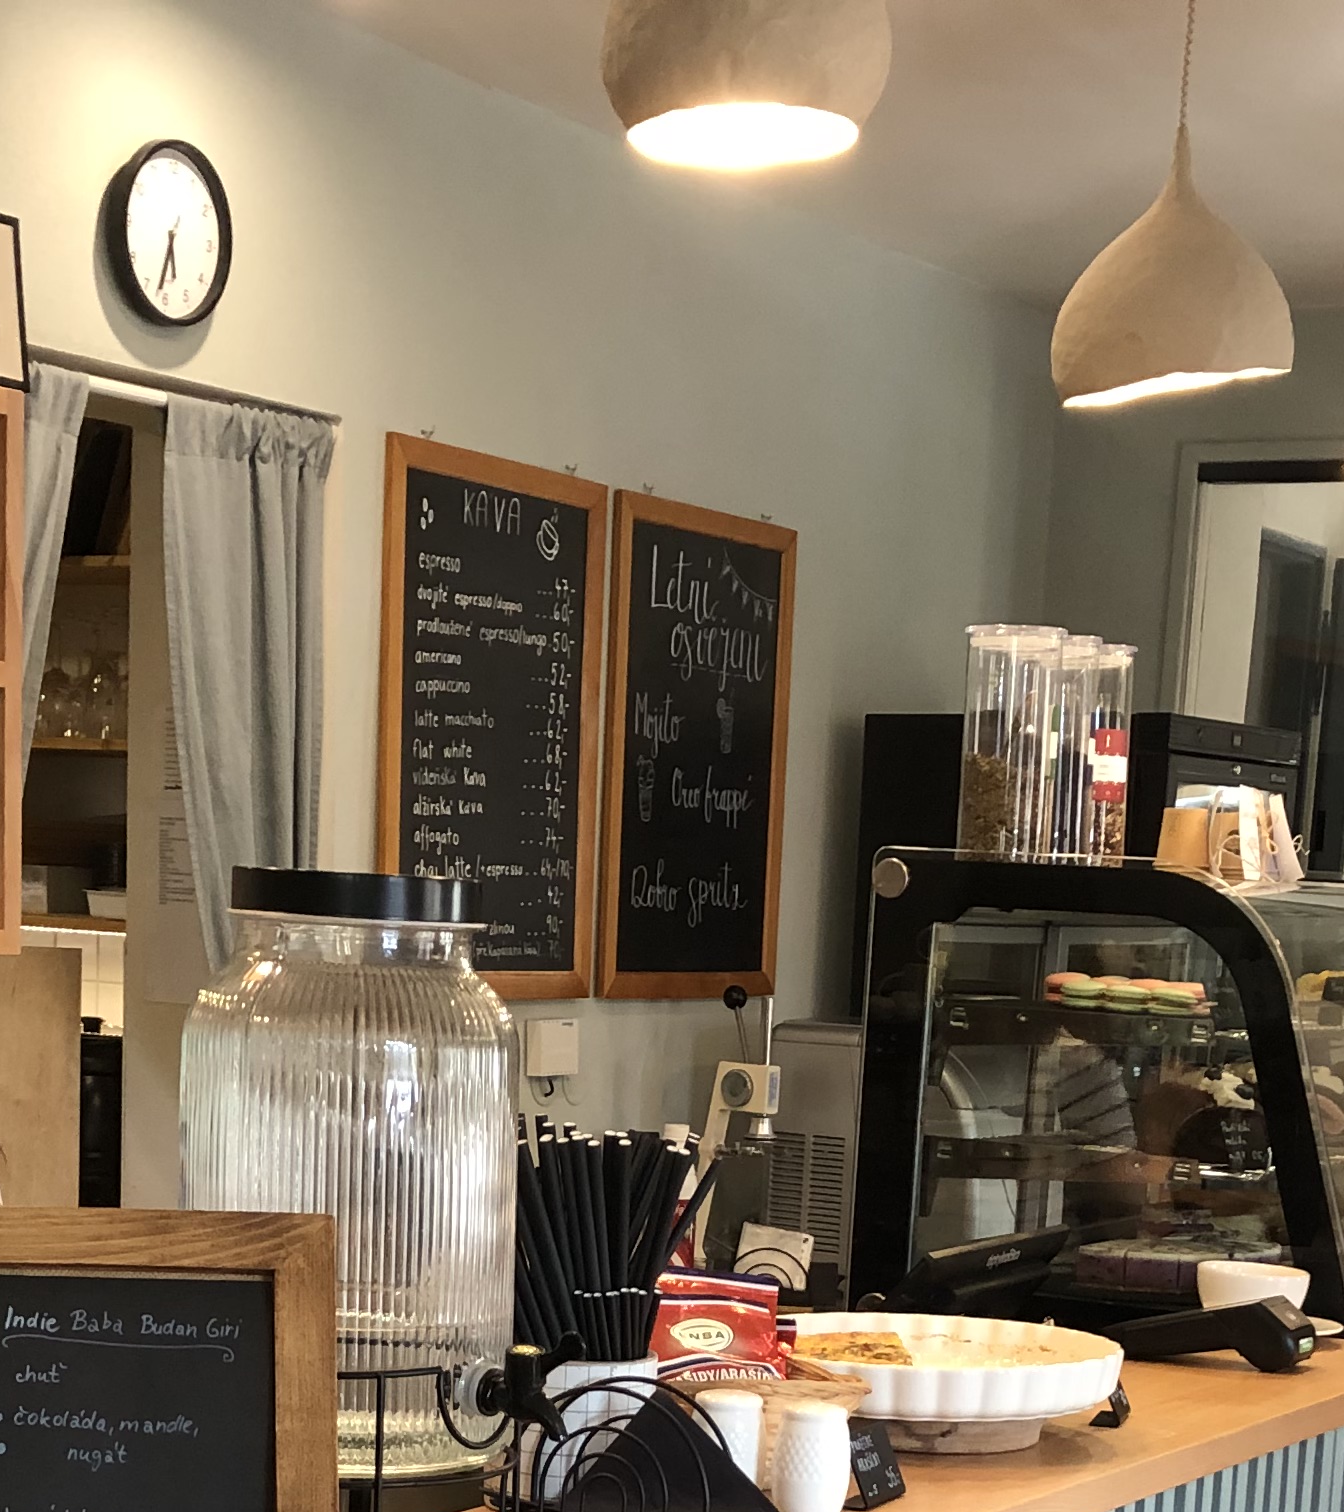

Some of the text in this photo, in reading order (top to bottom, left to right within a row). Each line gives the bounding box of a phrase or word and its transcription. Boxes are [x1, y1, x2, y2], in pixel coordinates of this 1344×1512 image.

[418, 552, 461, 576] espresso
[415, 650, 462, 665] americano
[415, 679, 471, 699] cappuccino
[414, 709, 439, 728] latte
[444, 708, 494, 728] macchiato
[634, 691, 686, 759] Mojito
[413, 738, 434, 759] flat
[443, 738, 472, 759] white
[413, 824, 459, 855] affogato
[444, 855, 472, 878] latte
[687, 861, 748, 928] spritz
[5, 1306, 243, 1339] Indie Baba Budan Giri
[15, 1362, 68, 1383] chuť
[67, 1441, 128, 1472] nugát
